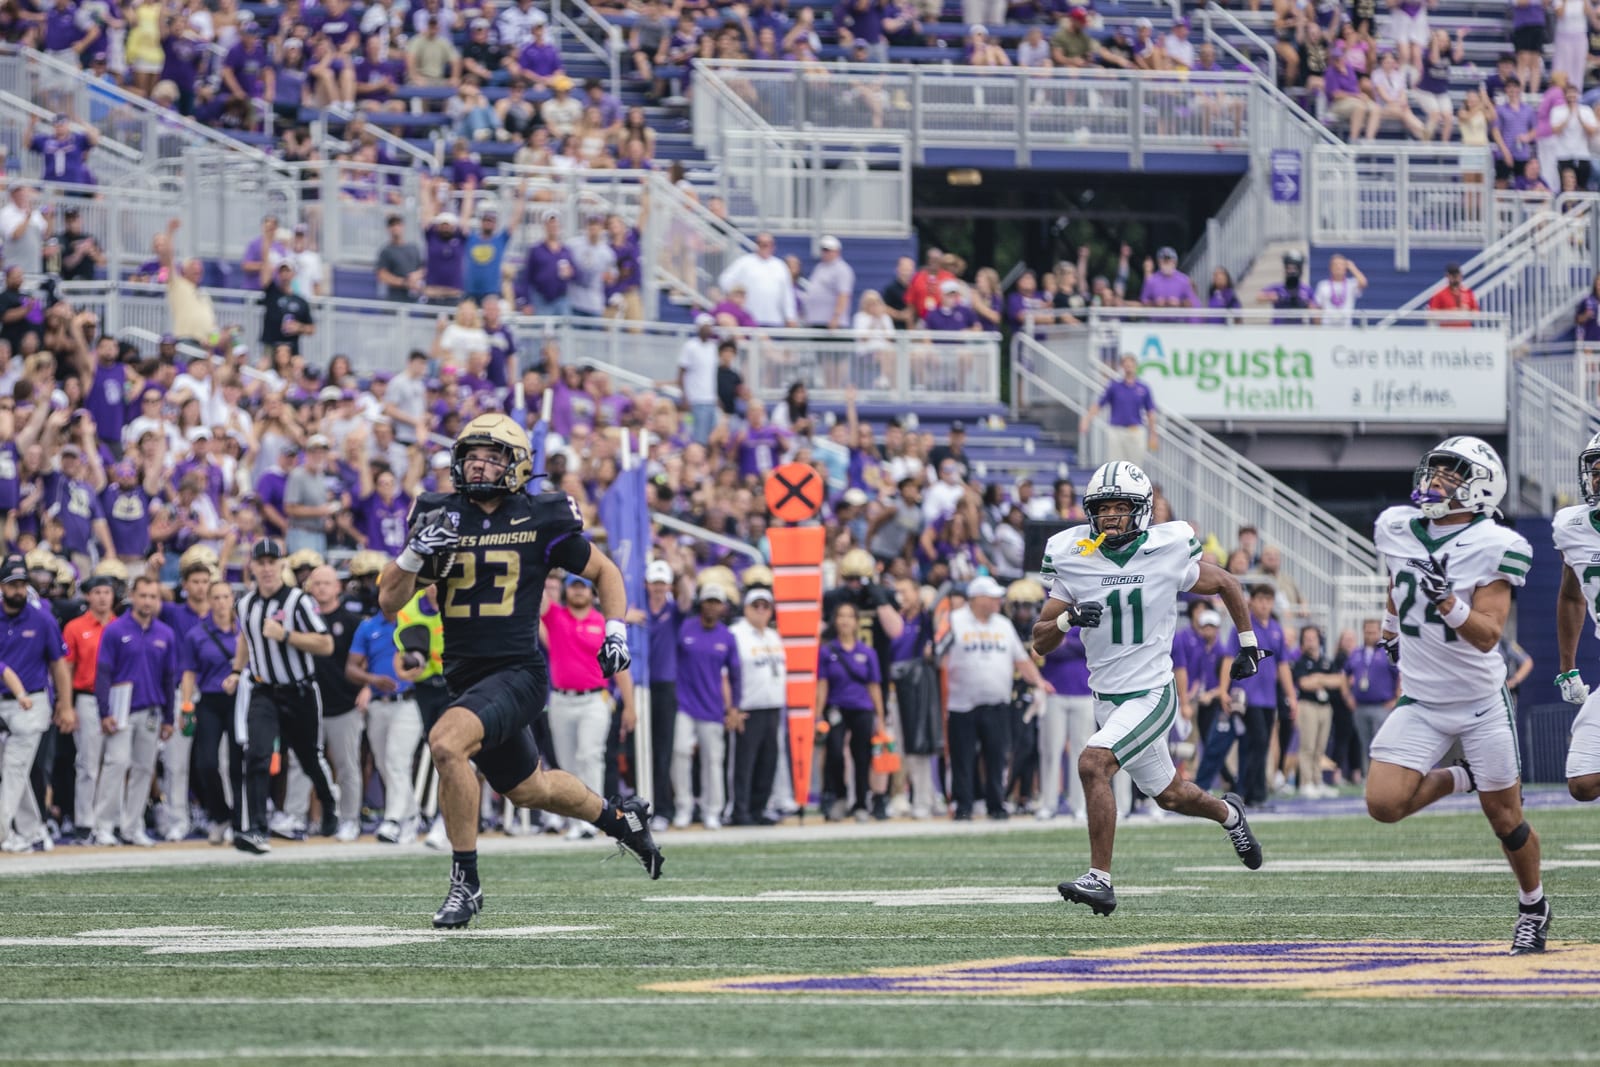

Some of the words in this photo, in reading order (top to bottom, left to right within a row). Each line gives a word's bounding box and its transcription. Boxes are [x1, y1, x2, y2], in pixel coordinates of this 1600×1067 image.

[1137, 335, 1314, 391] Augusta
[1331, 346, 1378, 369] Care
[1385, 348, 1424, 369] that
[1432, 349, 1494, 369] makes
[1224, 381, 1314, 409] Health
[1352, 387, 1362, 404] a
[478, 531, 537, 546] MADISON
[445, 550, 521, 618] 23
[1101, 575, 1145, 586] WAGNER
[1106, 587, 1144, 645] 11
